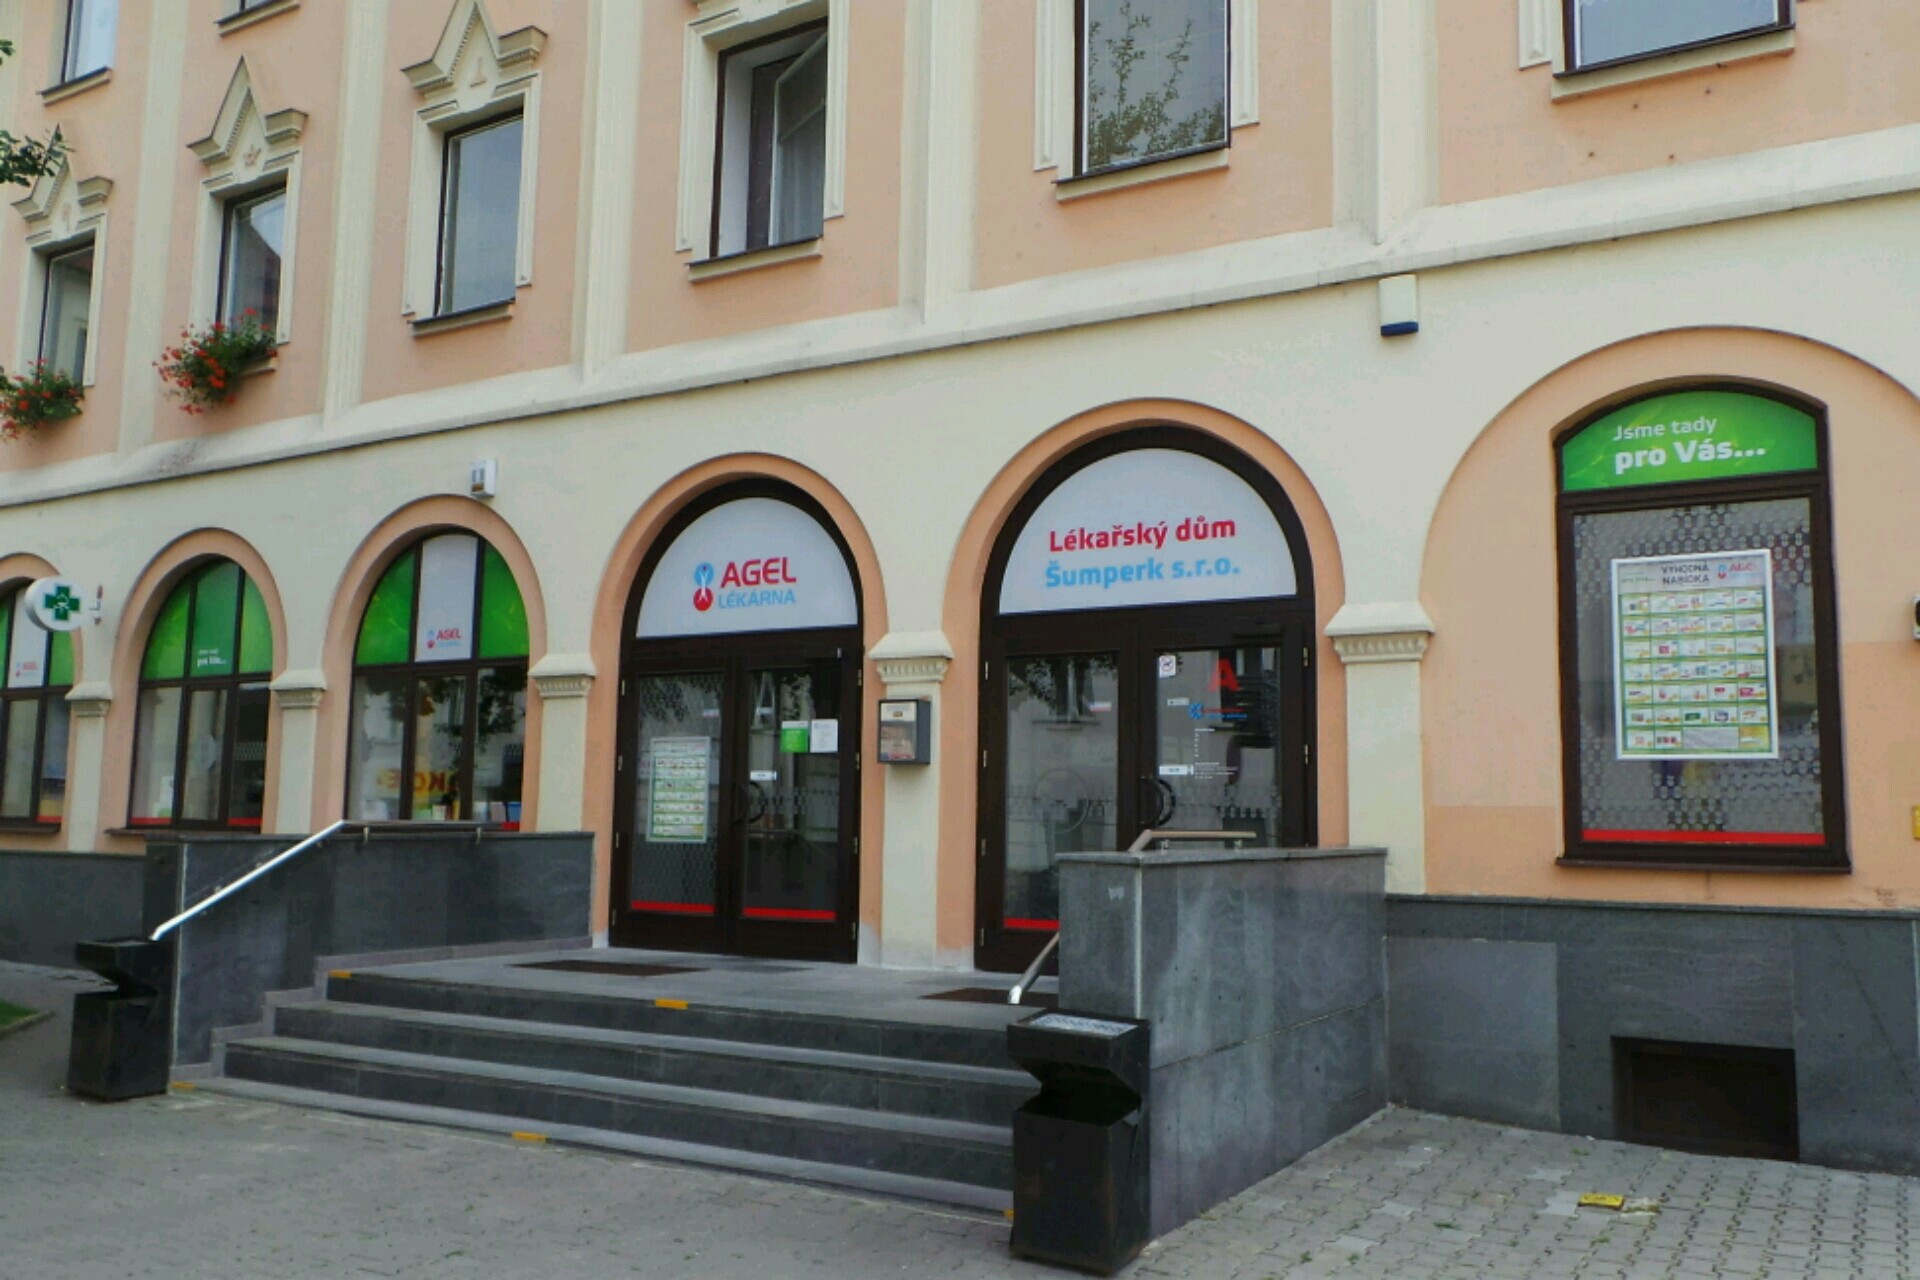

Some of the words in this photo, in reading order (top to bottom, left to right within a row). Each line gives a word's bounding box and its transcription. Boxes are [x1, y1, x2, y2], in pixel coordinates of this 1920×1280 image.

[1613, 423, 1665, 441] Jsme
[1671, 416, 1718, 435] tady
[1615, 448, 1667, 475] pro
[1673, 438, 1766, 463] Vás...
[1050, 521, 1168, 552] Lékařský
[1176, 515, 1236, 542] dům
[720, 556, 798, 588] AGEL
[1045, 557, 1165, 589] Šumperk
[1171, 557, 1241, 579] s.r.o.
[718, 589, 796, 609] LÉKÁRNA
